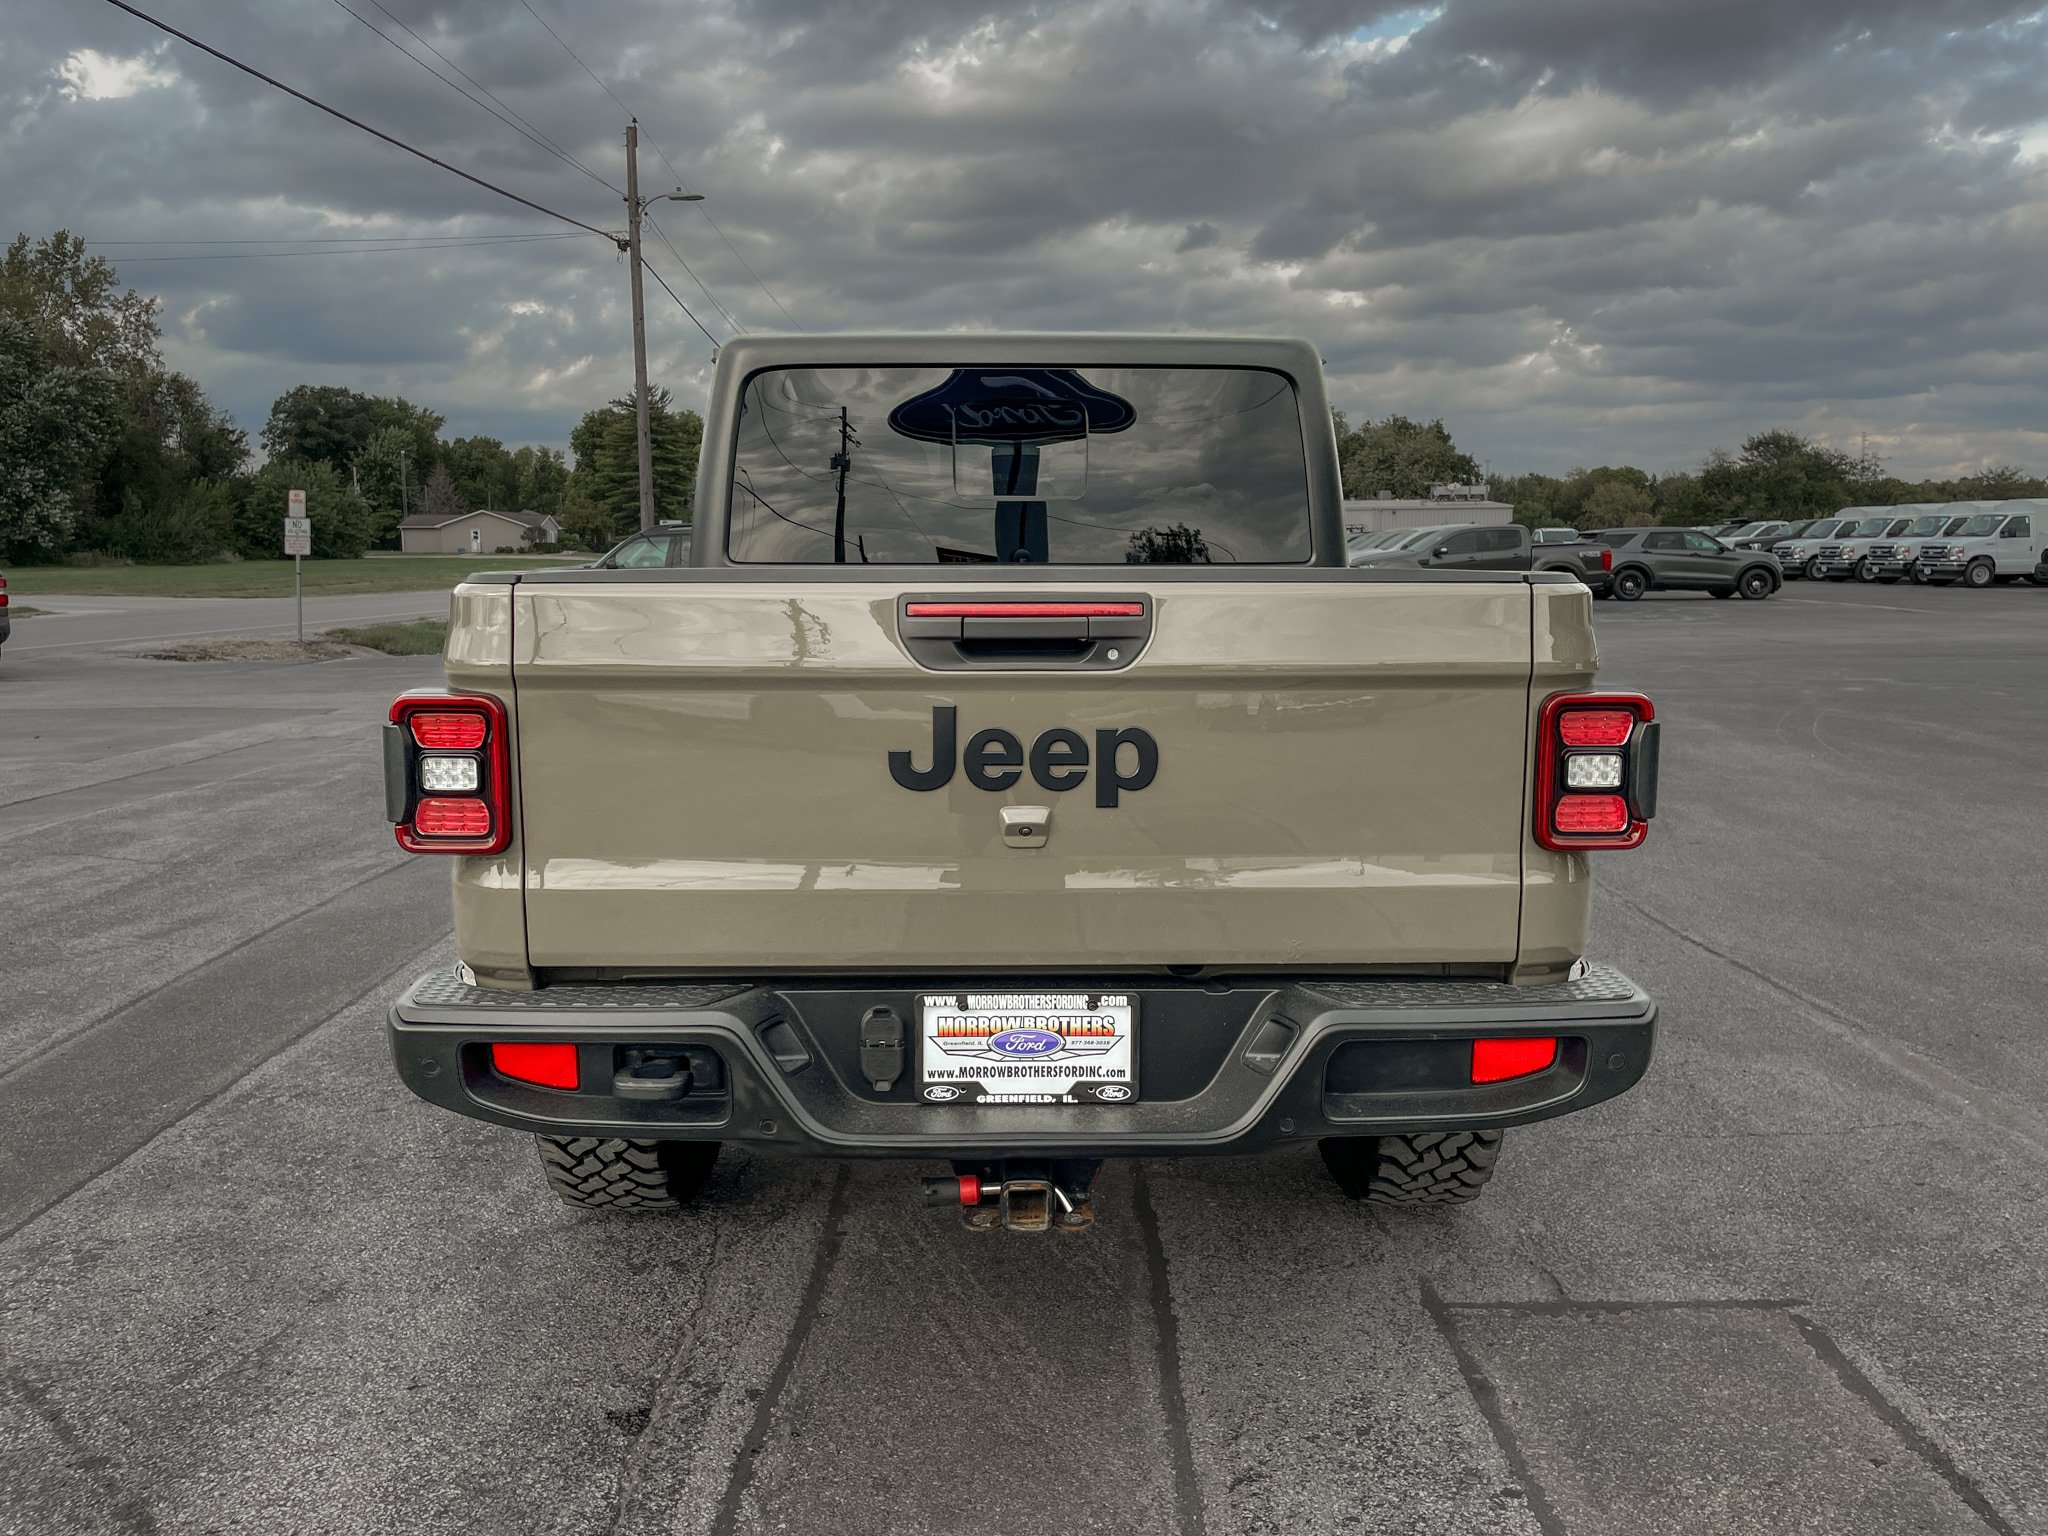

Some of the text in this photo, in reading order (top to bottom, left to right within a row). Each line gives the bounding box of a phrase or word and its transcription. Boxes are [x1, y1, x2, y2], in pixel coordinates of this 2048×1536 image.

[292, 520, 303, 529] NO
[888, 705, 1159, 808] Jeep
[924, 995, 959, 1007] www.
[967, 995, 1088, 1010] MORROWBROTHERSFORDINC
[937, 1015, 1116, 1037] MORROW BROTHERS
[1005, 1033, 1047, 1051] Ford
[927, 1065, 1126, 1079] www.MORROWBROTHERSFORDINC.com
[930, 1087, 953, 1098] Ford
[976, 1094, 1078, 1104] GREENFIELD, IL.
[1102, 1087, 1124, 1098] Ford
